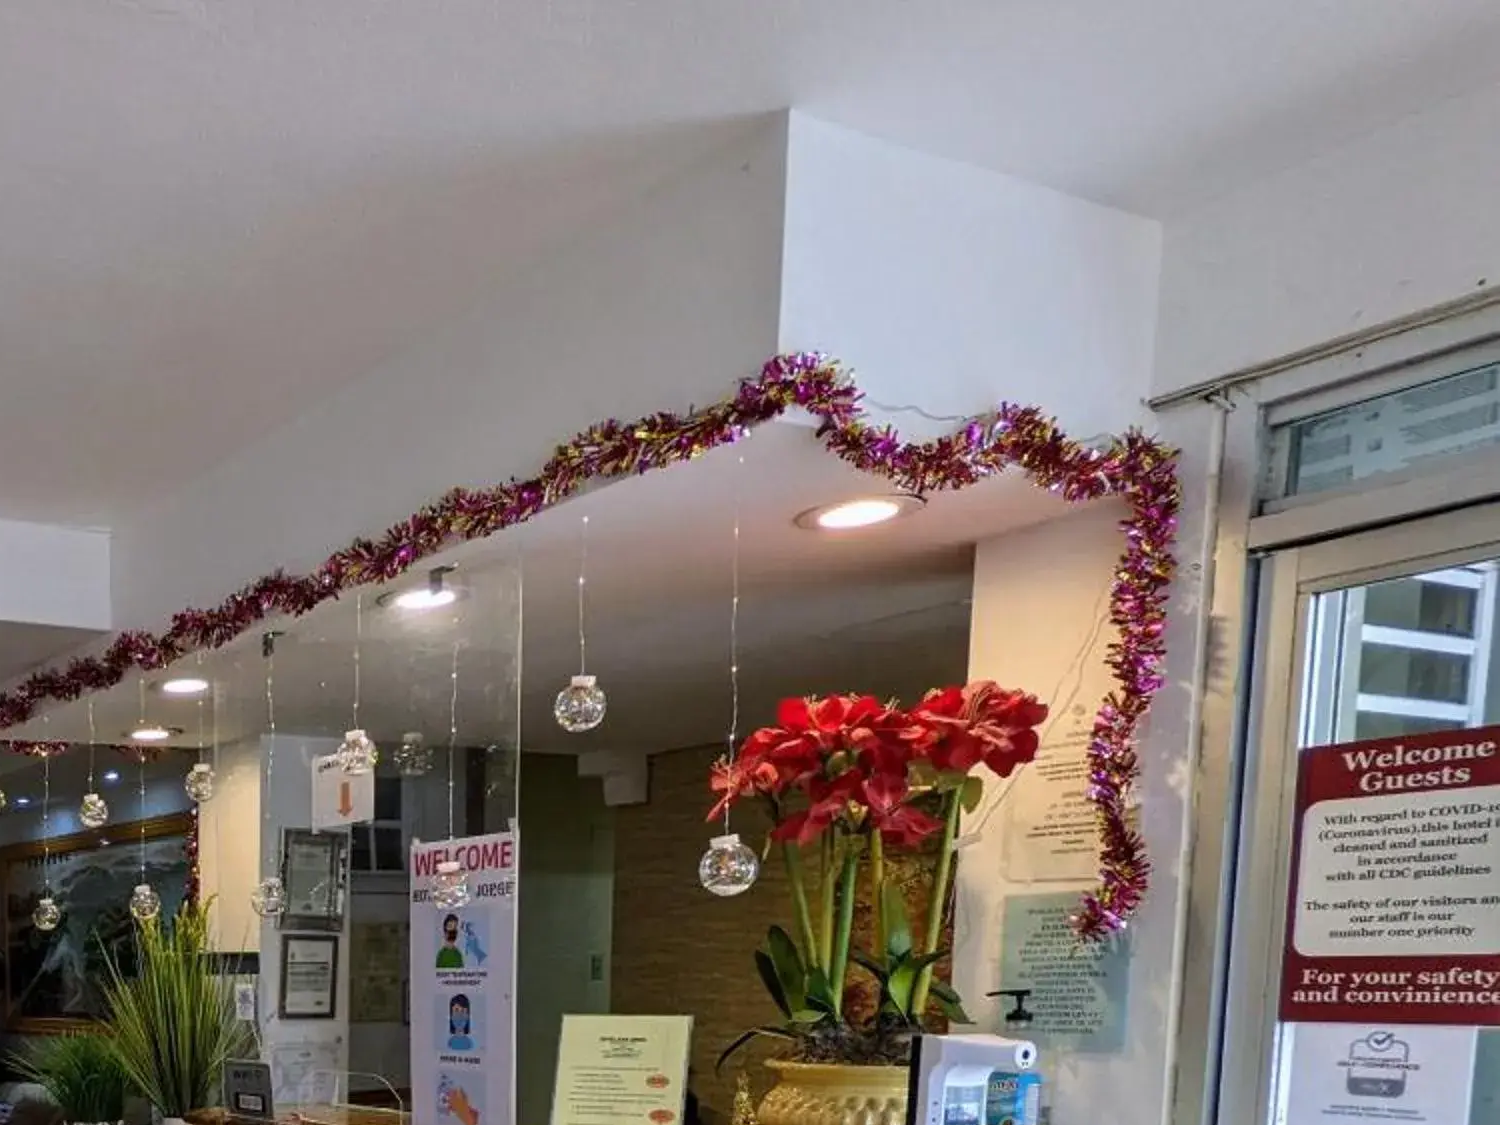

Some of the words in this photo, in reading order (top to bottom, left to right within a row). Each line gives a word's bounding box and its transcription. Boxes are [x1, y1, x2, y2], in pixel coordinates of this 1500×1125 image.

[1341, 740, 1497, 771] Welcome
[1359, 766, 1472, 792] Guests
[1324, 814, 1357, 826] With
[1361, 812, 1408, 825] regard
[1411, 809, 1426, 819] to
[1452, 817, 1492, 831] hotel
[1333, 841, 1386, 854] cleaned
[1389, 839, 1417, 850] and
[1419, 833, 1489, 848] sanitized
[1357, 855, 1371, 866] in
[1374, 851, 1458, 866] accordance
[1325, 870, 1355, 881] with
[1358, 869, 1376, 880] all
[1379, 867, 1412, 880] CDC
[1413, 864, 1492, 880] guidelines
[1305, 901, 1330, 911] The
[1332, 898, 1372, 911] safety
[1375, 897, 1390, 909] of
[1392, 898, 1419, 908] our
[1422, 895, 1478, 907] visitors
[1480, 894, 1500, 905] an
[1349, 914, 1375, 924] our
[1378, 911, 1410, 923] staff
[1413, 911, 1425, 922] is
[1427, 912, 1456, 922] our
[1329, 927, 1384, 938] number
[1387, 927, 1414, 938] one
[1416, 925, 1476, 938] priority
[1301, 968, 1347, 985] For
[1349, 970, 1413, 988] your
[1416, 966, 1500, 988] safety
[1291, 985, 1339, 1003] and
[1344, 986, 1500, 1004] convinience
